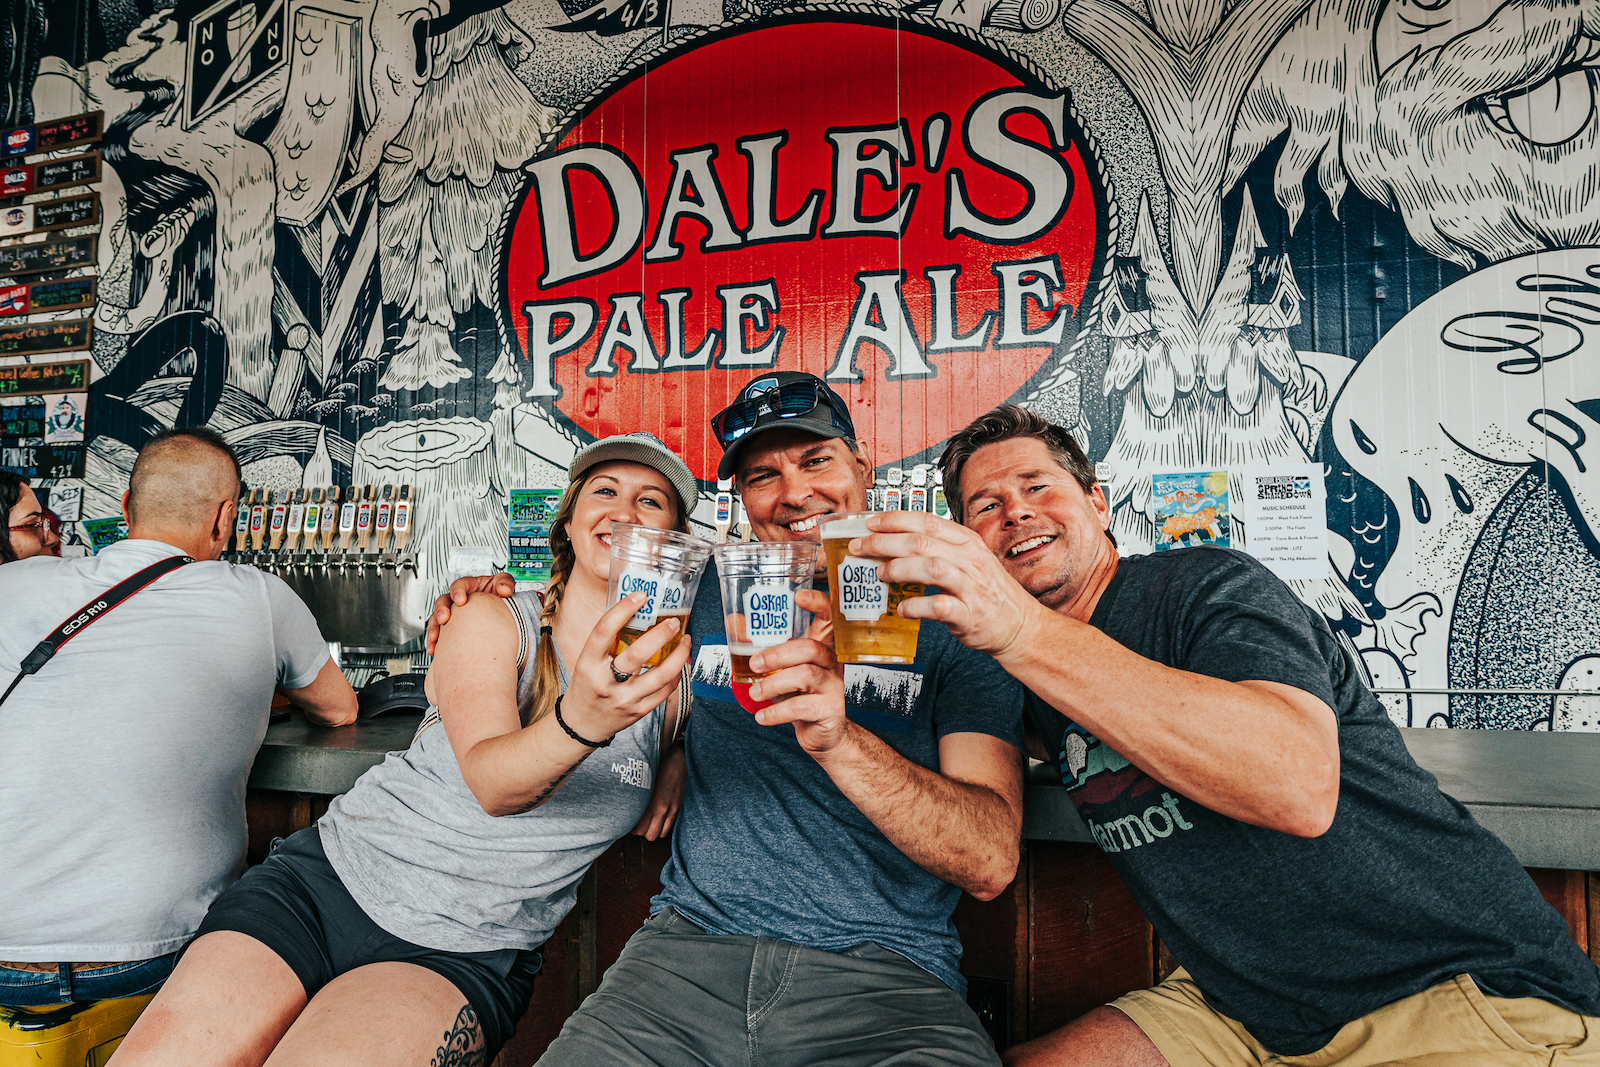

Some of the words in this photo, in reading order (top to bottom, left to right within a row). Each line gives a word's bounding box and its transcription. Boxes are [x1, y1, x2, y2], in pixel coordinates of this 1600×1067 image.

[620, 0, 658, 27] 4/3
[523, 88, 1071, 288] DALE'S
[16, 248, 38, 260] Lima
[522, 277, 787, 399] PALE
[824, 252, 1074, 384] ALE
[2, 447, 38, 467] PINNER
[1257, 489, 1312, 500] SHAKEDOWN
[1258, 484, 1293, 493] SPRING
[1184, 498, 1200, 508] LOOP
[622, 575, 658, 598] OSKAR
[843, 585, 882, 603] BLUES
[750, 592, 789, 612] OSKAR
[62, 613, 90, 636] EOS
[87, 600, 108, 616] R10
[751, 612, 788, 630] BLUES
[611, 762, 643, 779] NORTH
[627, 757, 643, 770] THE
[620, 773, 642, 788] FACE
